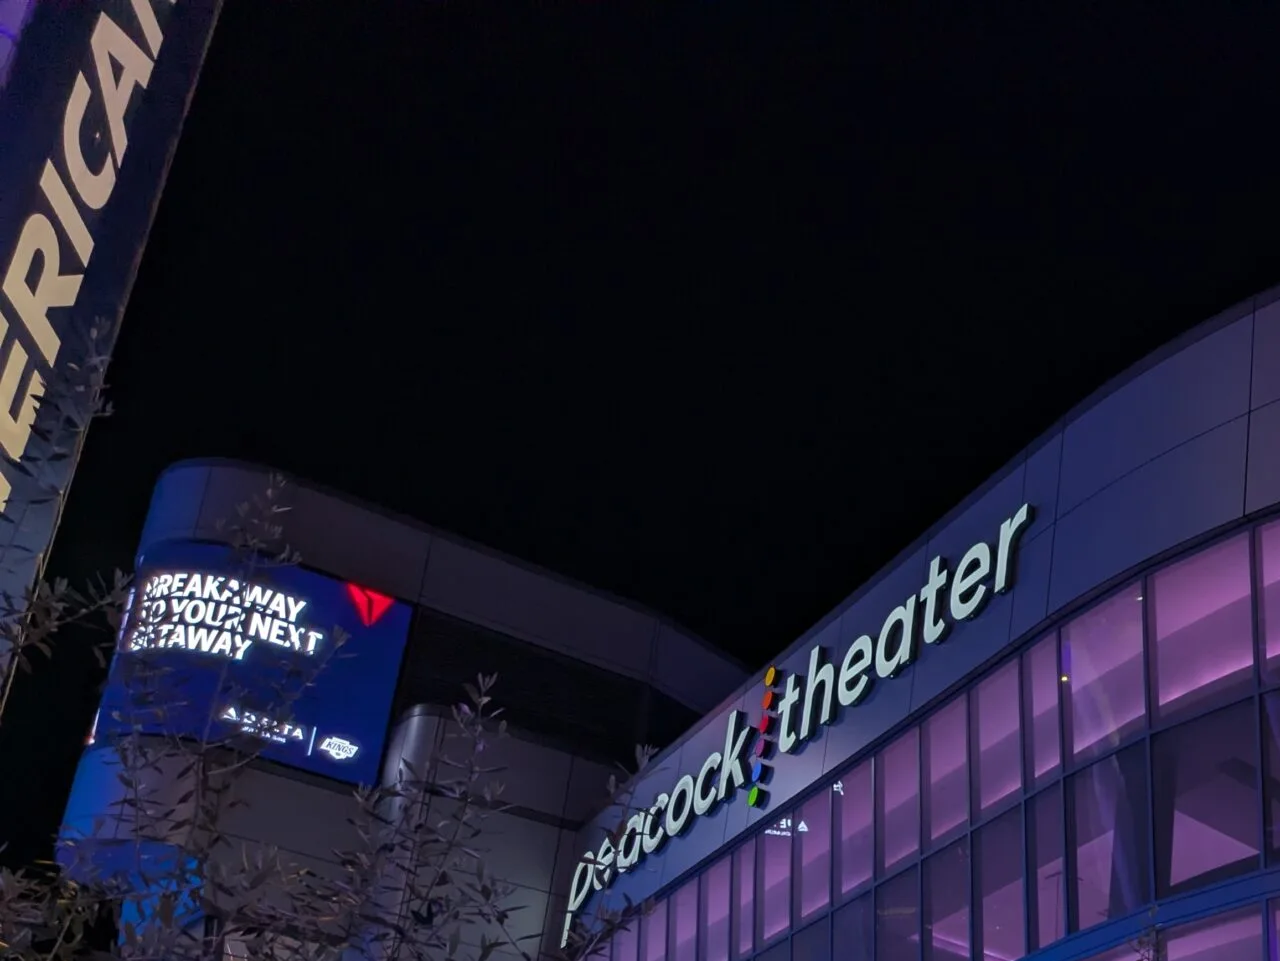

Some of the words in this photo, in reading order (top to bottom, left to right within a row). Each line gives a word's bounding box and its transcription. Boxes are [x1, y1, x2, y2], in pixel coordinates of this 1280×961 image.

[0, 0, 176, 512] ERICA
[144, 573, 306, 622] BREAKAWAY
[171, 598, 243, 632] YOUR
[249, 614, 323, 655] NEXT
[777, 503, 1034, 753] theater
[243, 711, 303, 740] DETA
[324, 740, 354, 755] KINGS
[560, 709, 753, 948] peacock
